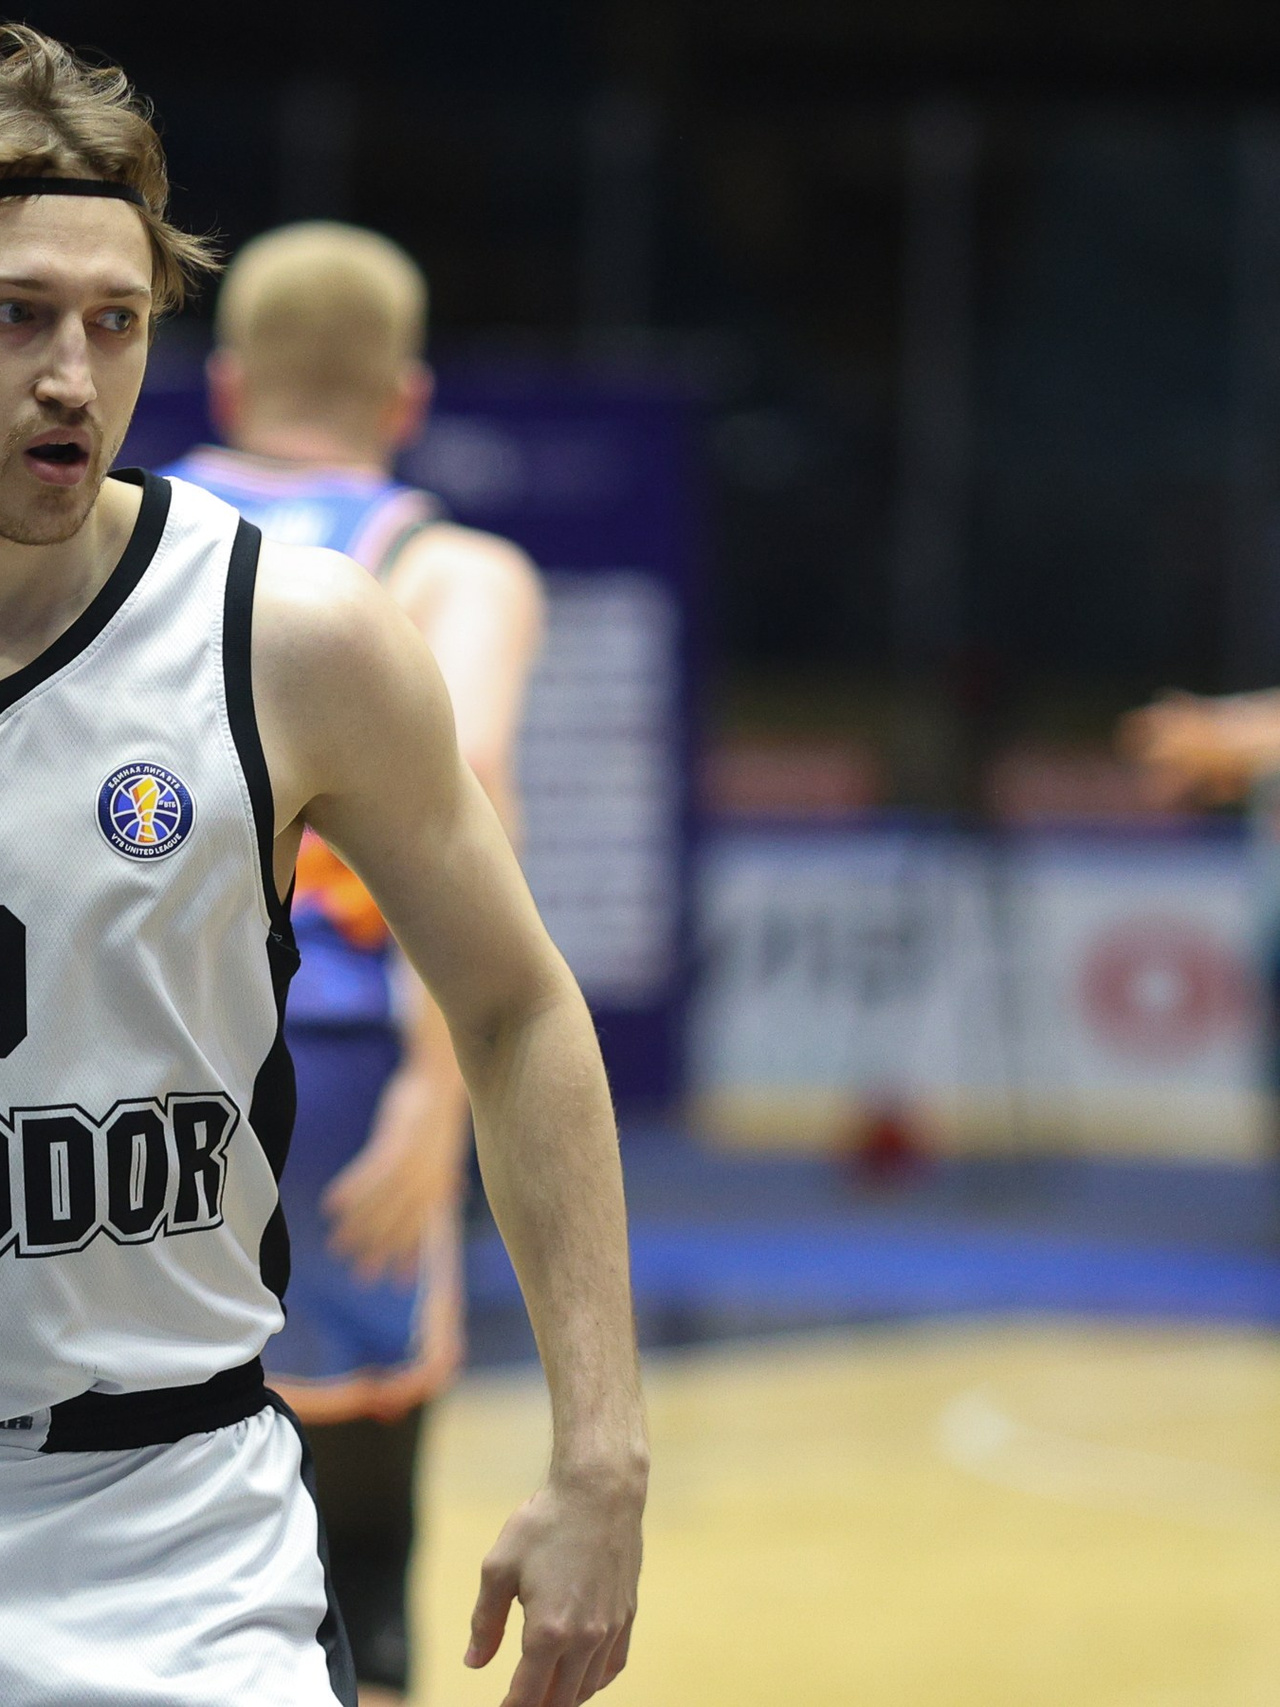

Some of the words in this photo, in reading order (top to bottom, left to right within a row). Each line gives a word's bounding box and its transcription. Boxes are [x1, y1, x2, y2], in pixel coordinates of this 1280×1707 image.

[108, 766, 140, 788] ЕДИНАЯ
[143, 766, 165, 778] ЛИГА
[166, 775, 180, 790] ВТБ
[111, 833, 124, 848] VTB
[125, 844, 154, 856] UNITED
[155, 833, 182, 854] LEAGUE
